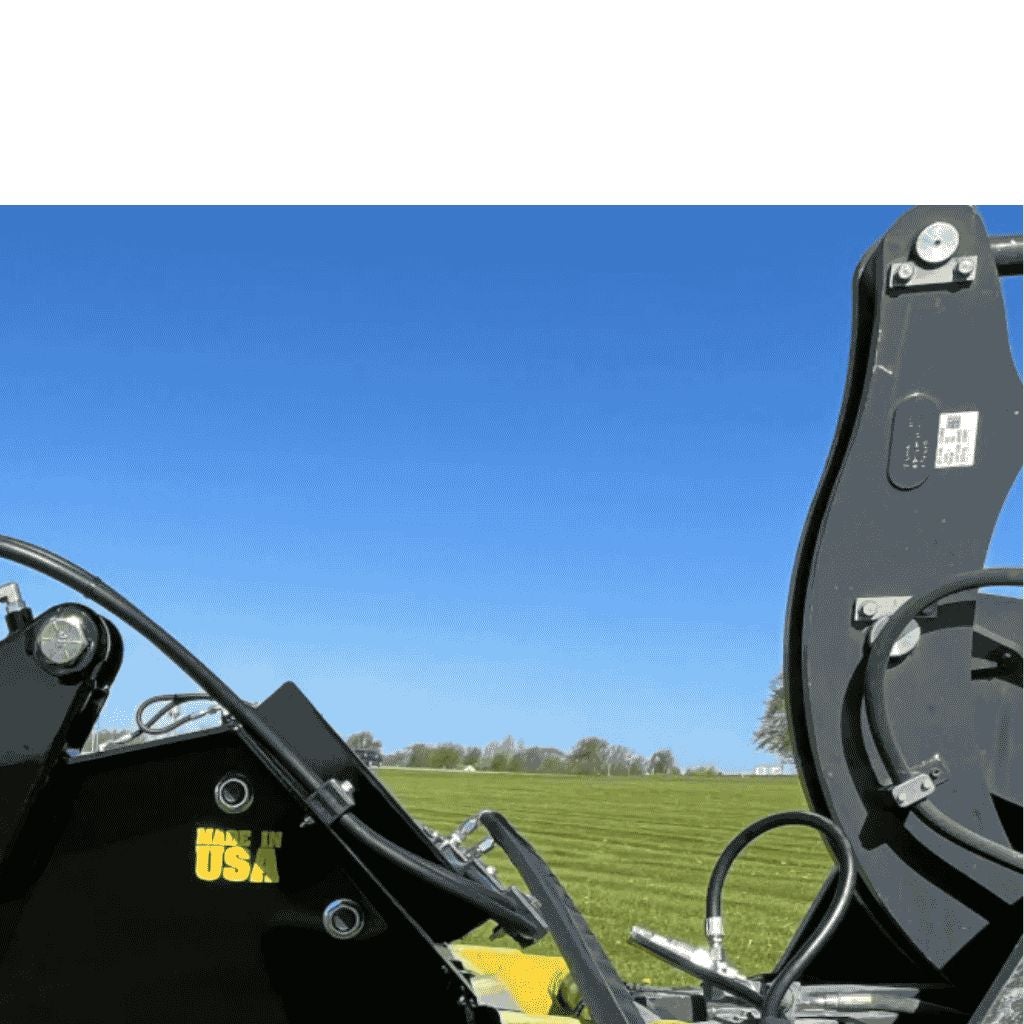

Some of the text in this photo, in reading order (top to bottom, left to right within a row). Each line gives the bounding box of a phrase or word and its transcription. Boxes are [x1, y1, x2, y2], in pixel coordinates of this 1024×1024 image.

[196, 828, 283, 848] MADE IN
[195, 845, 280, 883] USA
